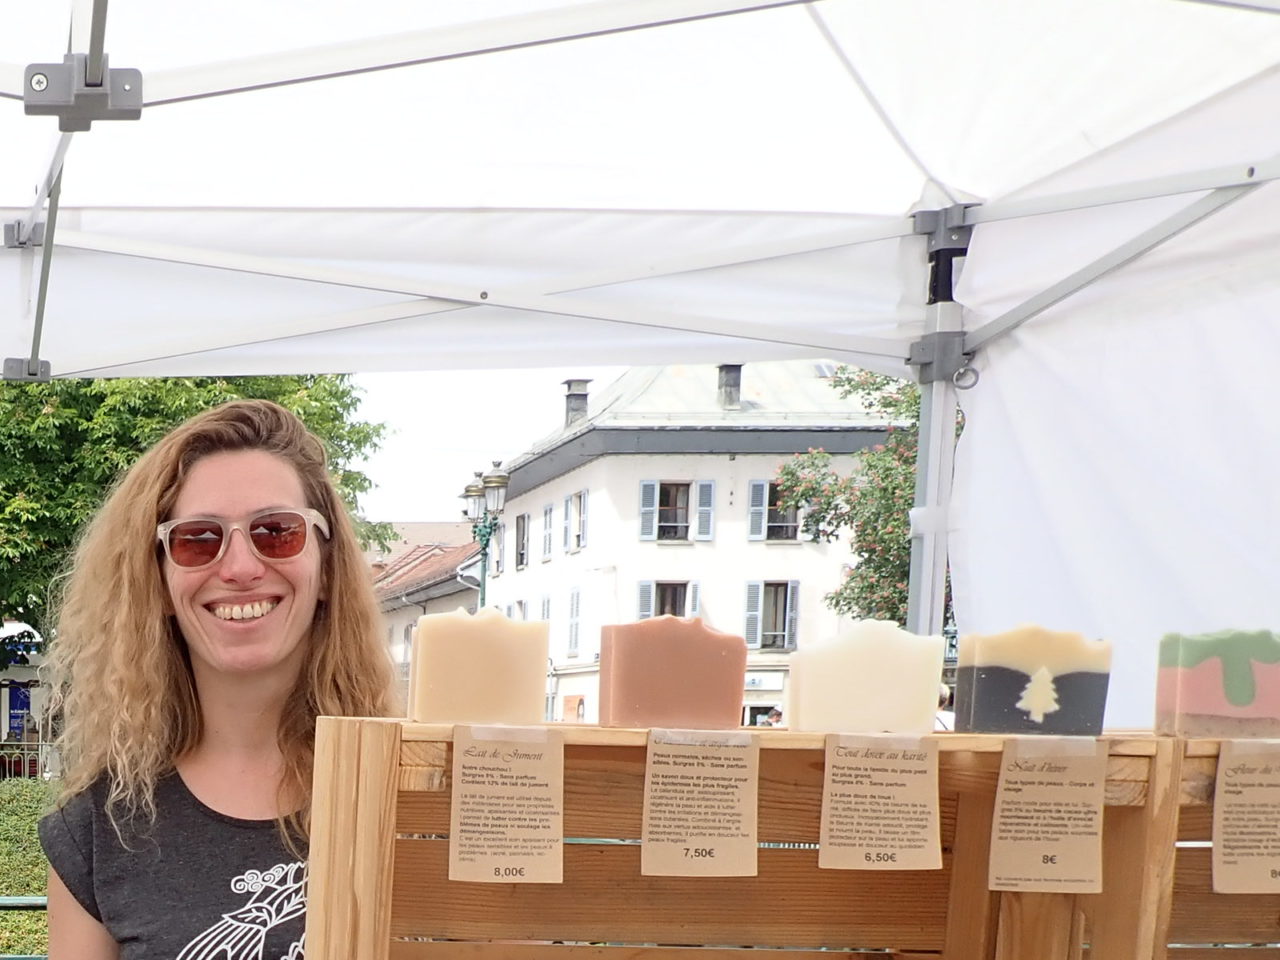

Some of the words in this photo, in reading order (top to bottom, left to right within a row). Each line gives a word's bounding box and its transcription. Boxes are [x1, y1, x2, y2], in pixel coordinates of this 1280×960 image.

[463, 746, 488, 758] Lait
[489, 749, 500, 758] de
[502, 749, 543, 763] Jument
[683, 848, 715, 858] 7,50€
[865, 853, 897, 863] 6,50€
[1042, 855, 1057, 864] 8€
[494, 867, 525, 878] 8,00€
